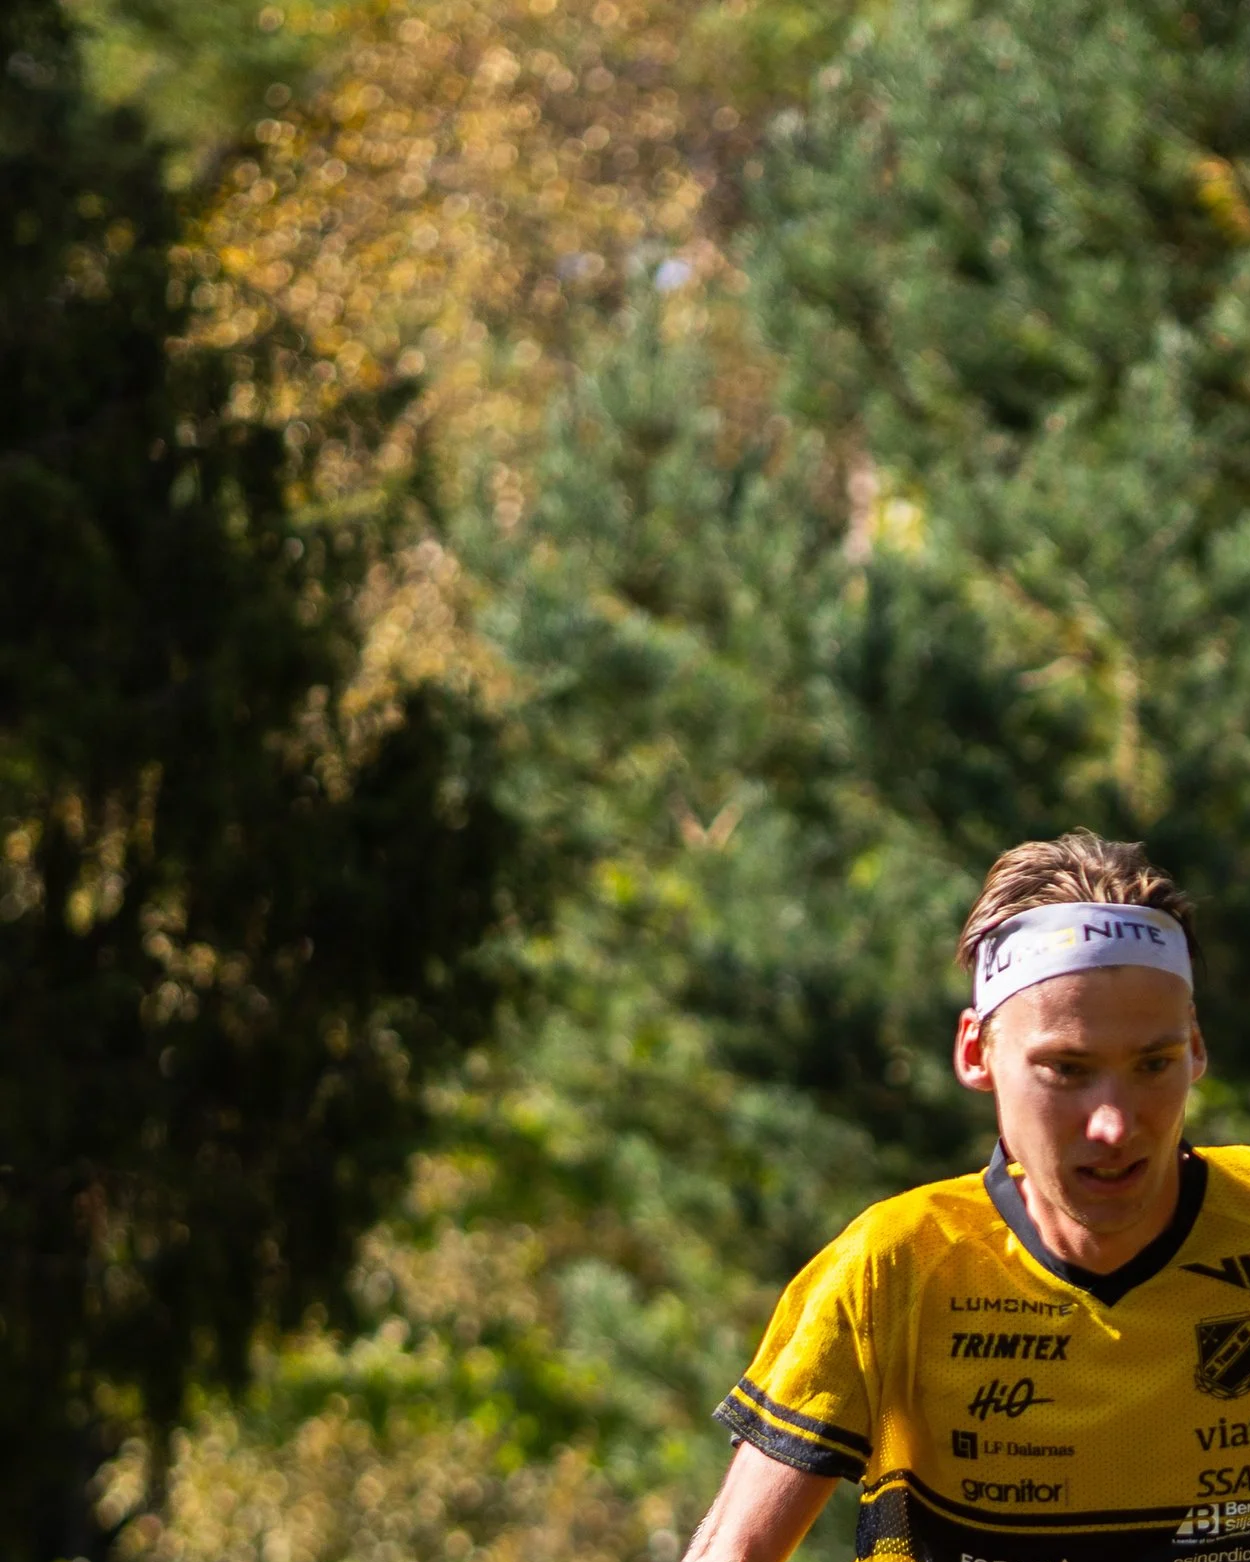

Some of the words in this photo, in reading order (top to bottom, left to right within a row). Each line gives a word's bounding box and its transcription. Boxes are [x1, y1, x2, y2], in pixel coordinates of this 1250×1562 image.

[950, 1297, 1074, 1317] LUMONITE
[950, 1333, 1072, 1360] TRIMTEX
[984, 1440, 1003, 1455] LF
[1007, 1442, 1076, 1457] Dalarnas
[961, 1478, 1063, 1502] granitor
